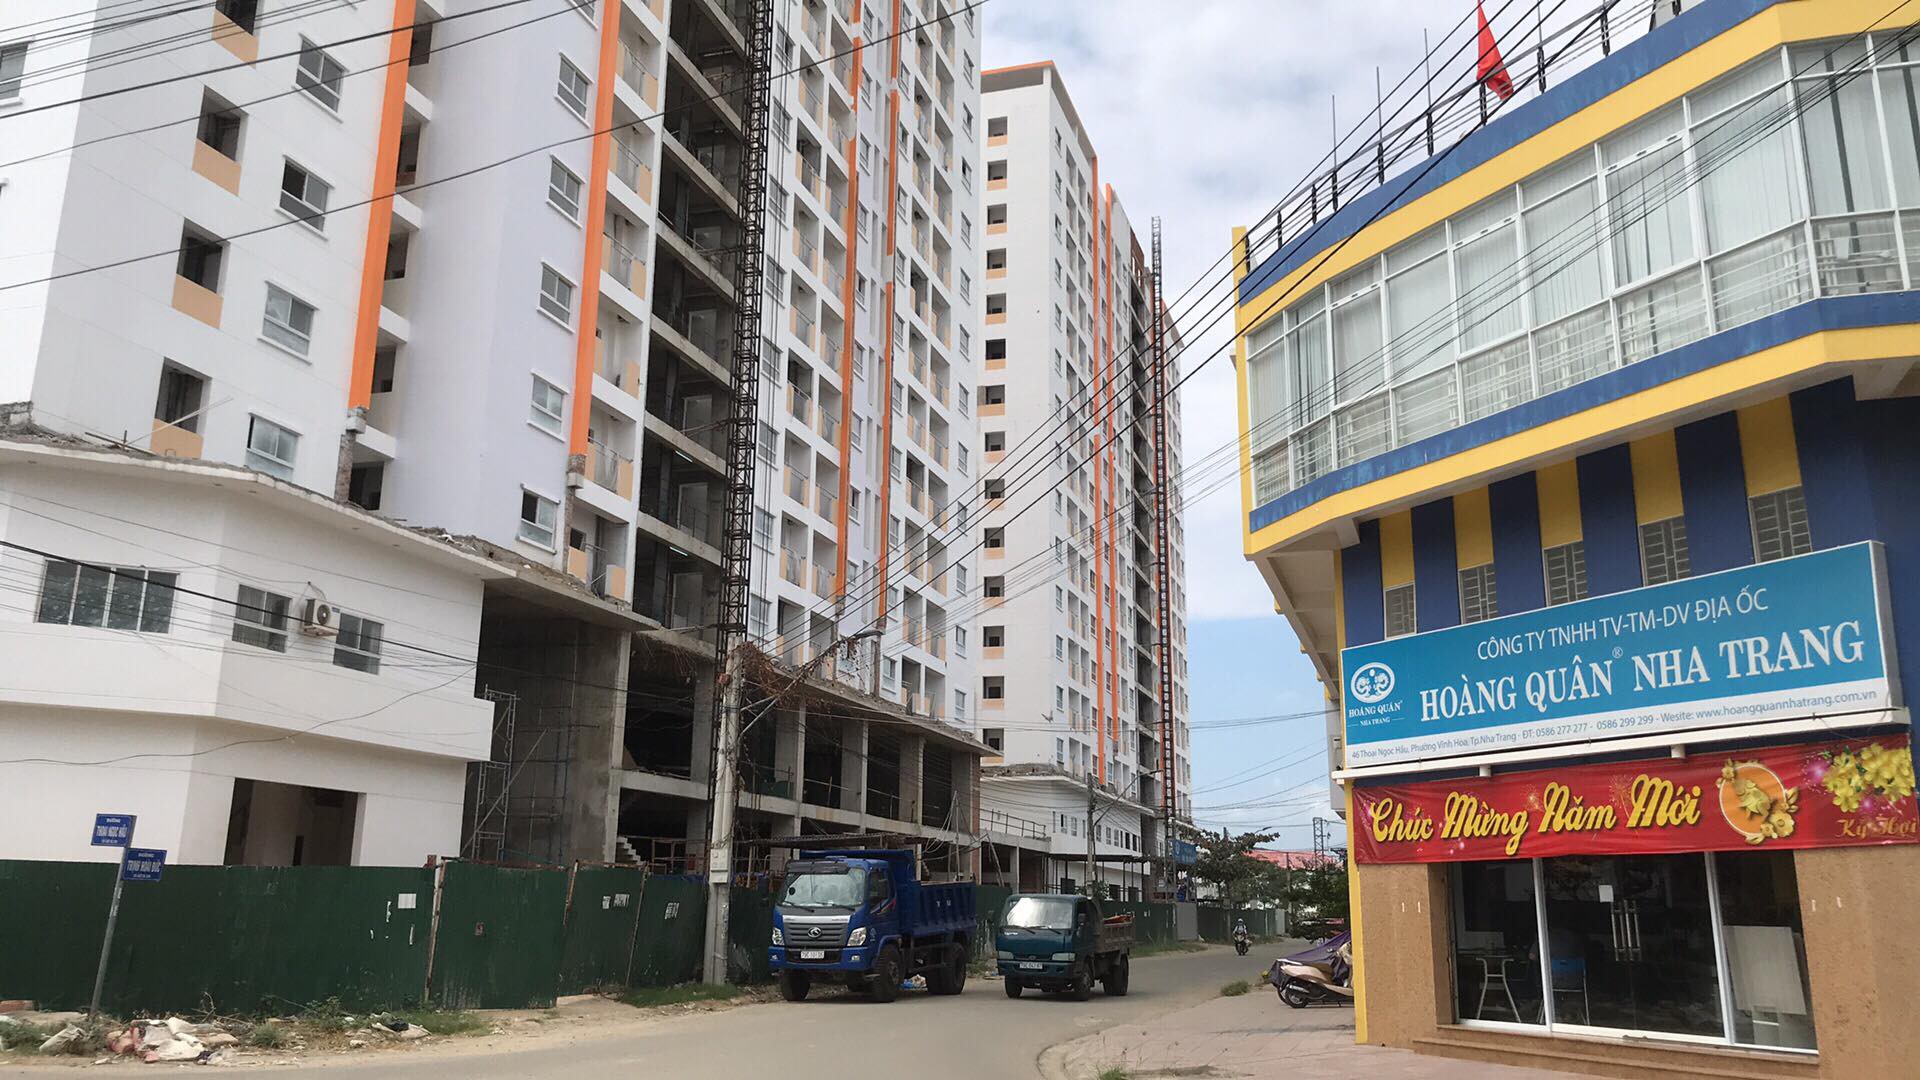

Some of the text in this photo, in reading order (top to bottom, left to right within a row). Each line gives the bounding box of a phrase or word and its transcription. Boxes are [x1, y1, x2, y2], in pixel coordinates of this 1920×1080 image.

[1477, 584, 1769, 660] CÔNG TY TNHH TV-TM-DV ĐỊA ỐC
[1419, 620, 1865, 722] HOÀNG QUÂN NHA TRANG
[1536, 727, 1556, 738] 0586
[1596, 720, 1618, 730] 0586
[1620, 717, 1636, 728] 299
[1637, 714, 1654, 726] 299
[1695, 690, 1877, 719] www.hoangquannhatrang.com.vn
[1370, 773, 1701, 856] Chúc Mừng Năm Mới
